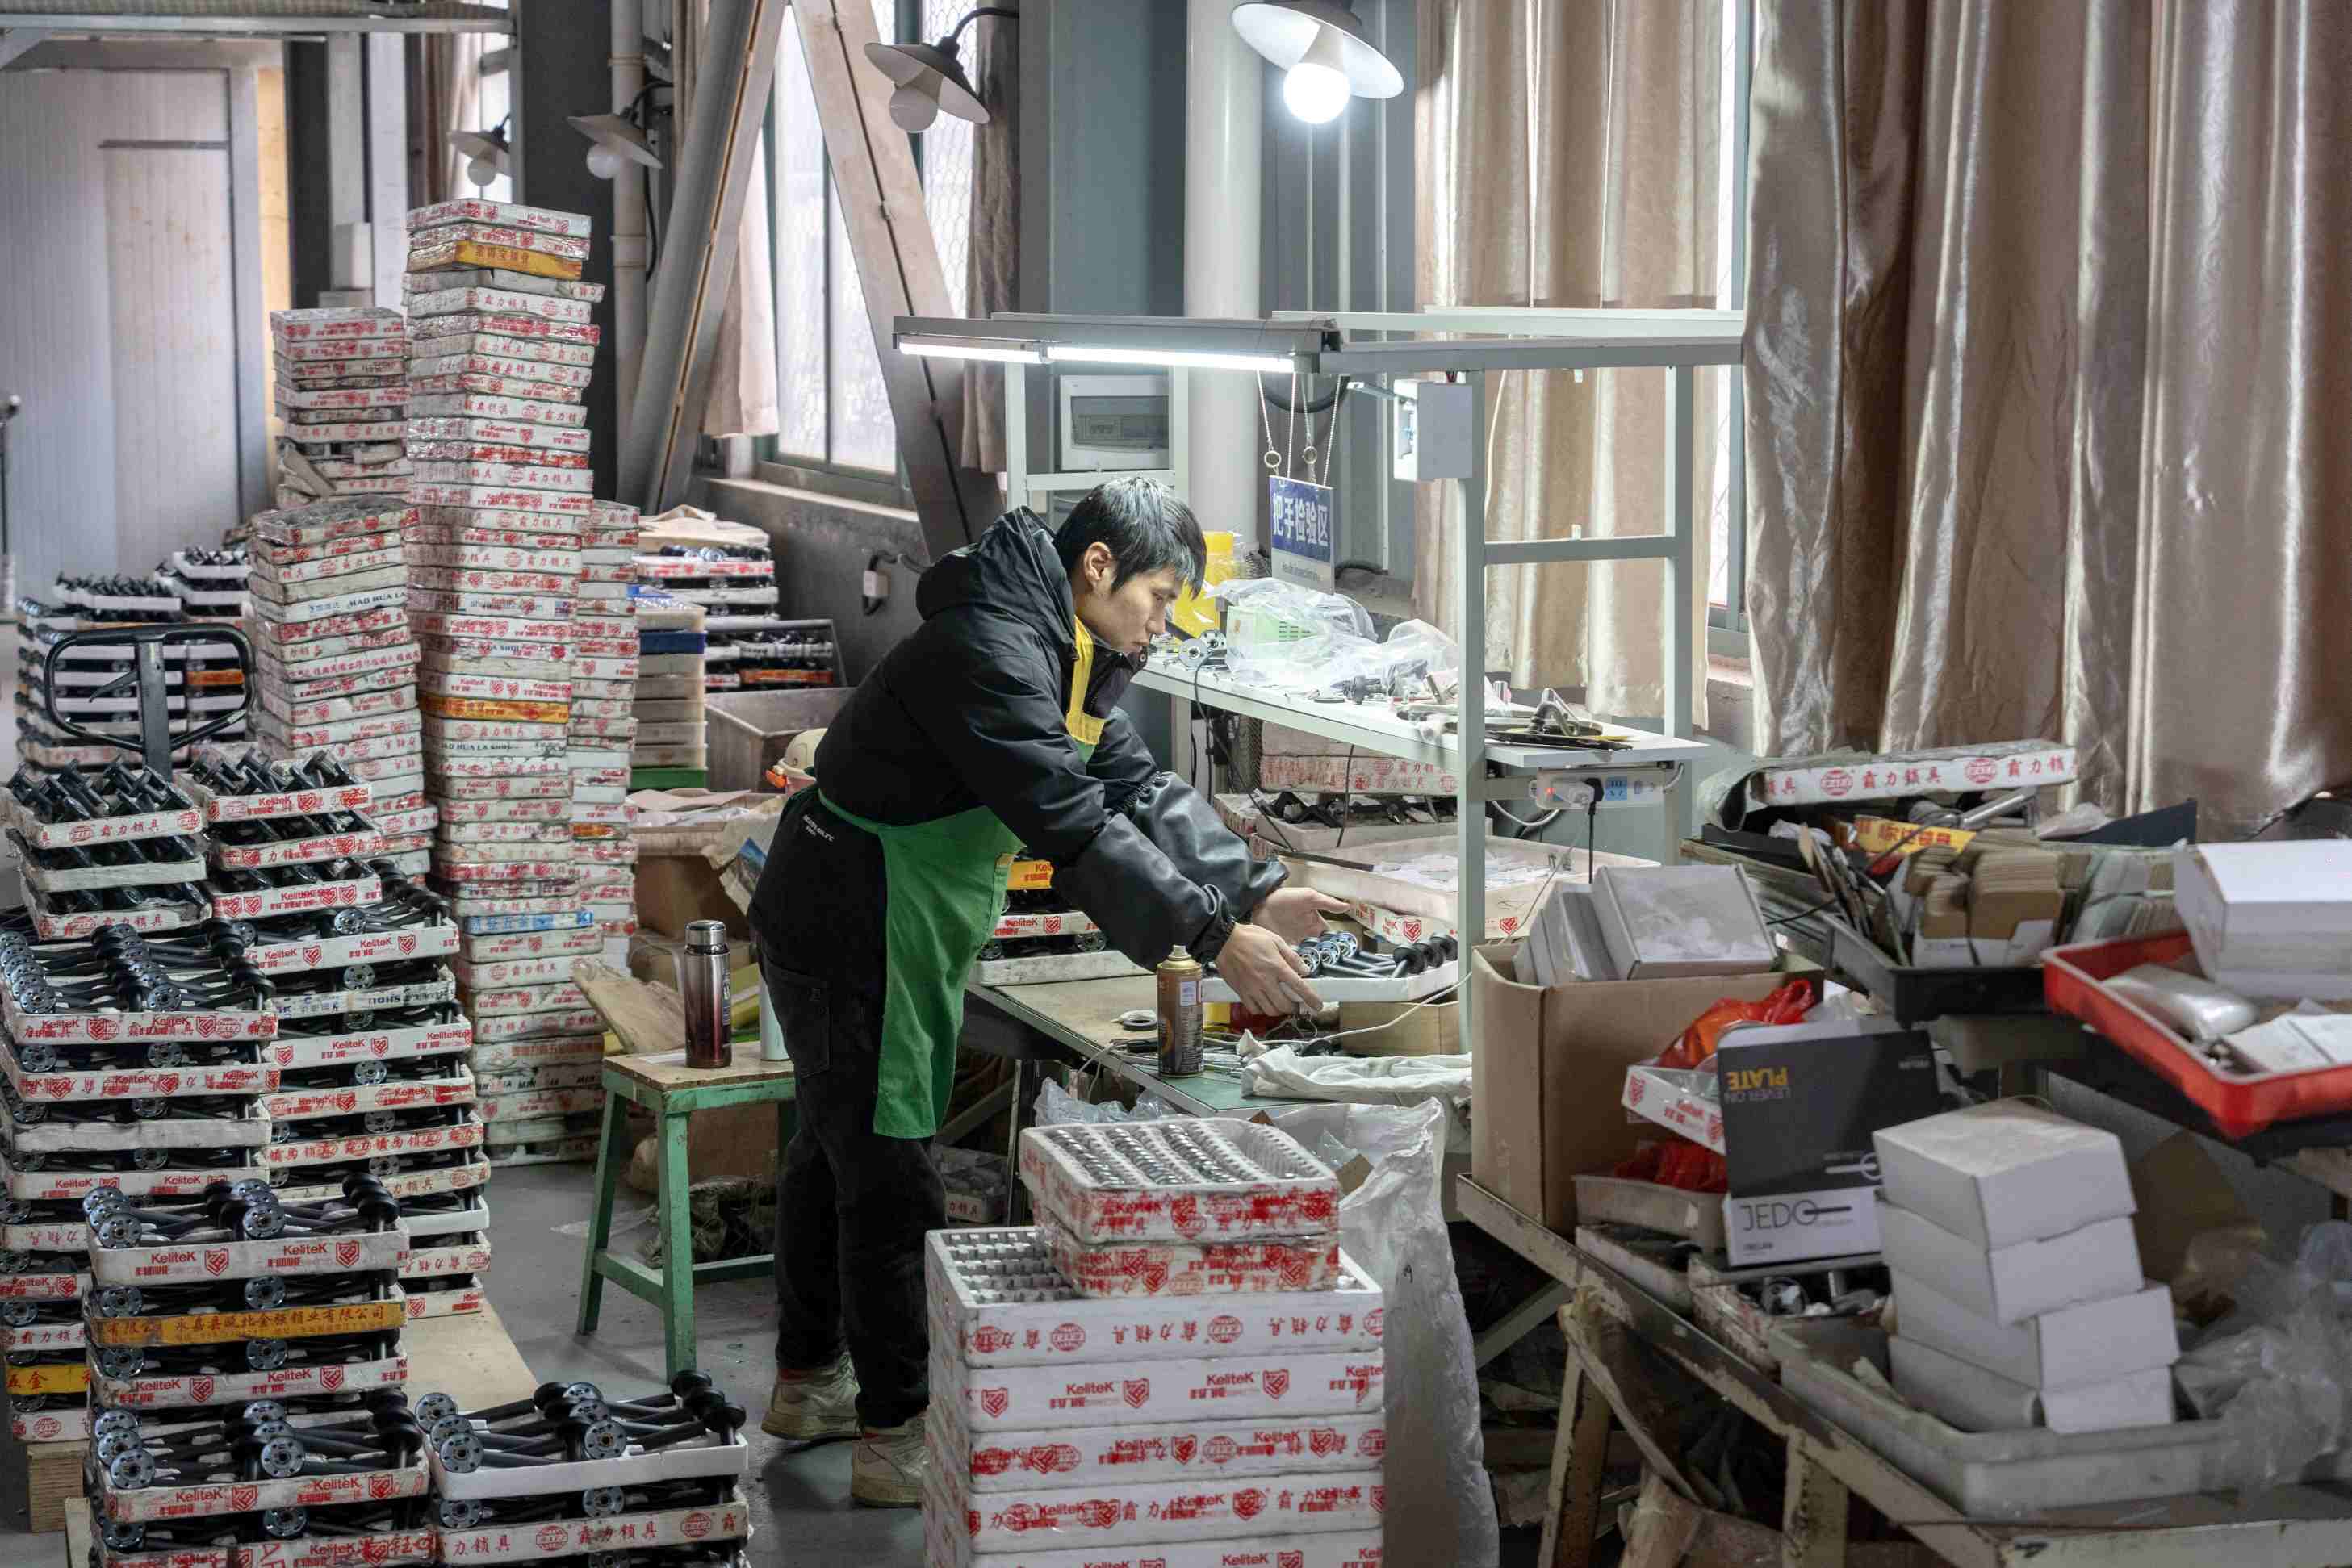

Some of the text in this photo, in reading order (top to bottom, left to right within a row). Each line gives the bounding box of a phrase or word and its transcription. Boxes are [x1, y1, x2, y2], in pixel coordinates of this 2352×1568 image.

[1273, 492, 1329, 546] 把手检验区
[360, 937, 392, 948] KeliteK
[265, 948, 298, 960] KeliteK
[332, 1039, 366, 1050] KeliteK
[1727, 1066, 1788, 1093] PLATE
[56, 1177, 93, 1189] KeliteK
[165, 1174, 201, 1185] KeliteK
[1739, 1199, 1819, 1231] JEDO
[284, 1243, 328, 1256] KeliteK
[151, 1251, 196, 1264] KeliteK
[267, 1369, 312, 1382] KeliteK
[1207, 1372, 1254, 1386] KeliteK
[136, 1378, 182, 1391] KeliteK
[1066, 1382, 1115, 1395] KeliteK
[1253, 1431, 1300, 1444] KeliteK
[1115, 1438, 1163, 1451] KeliteK
[316, 1478, 361, 1491] KeliteK
[176, 1490, 223, 1503] KeliteK
[1223, 1553, 1269, 1567] KeliteK
